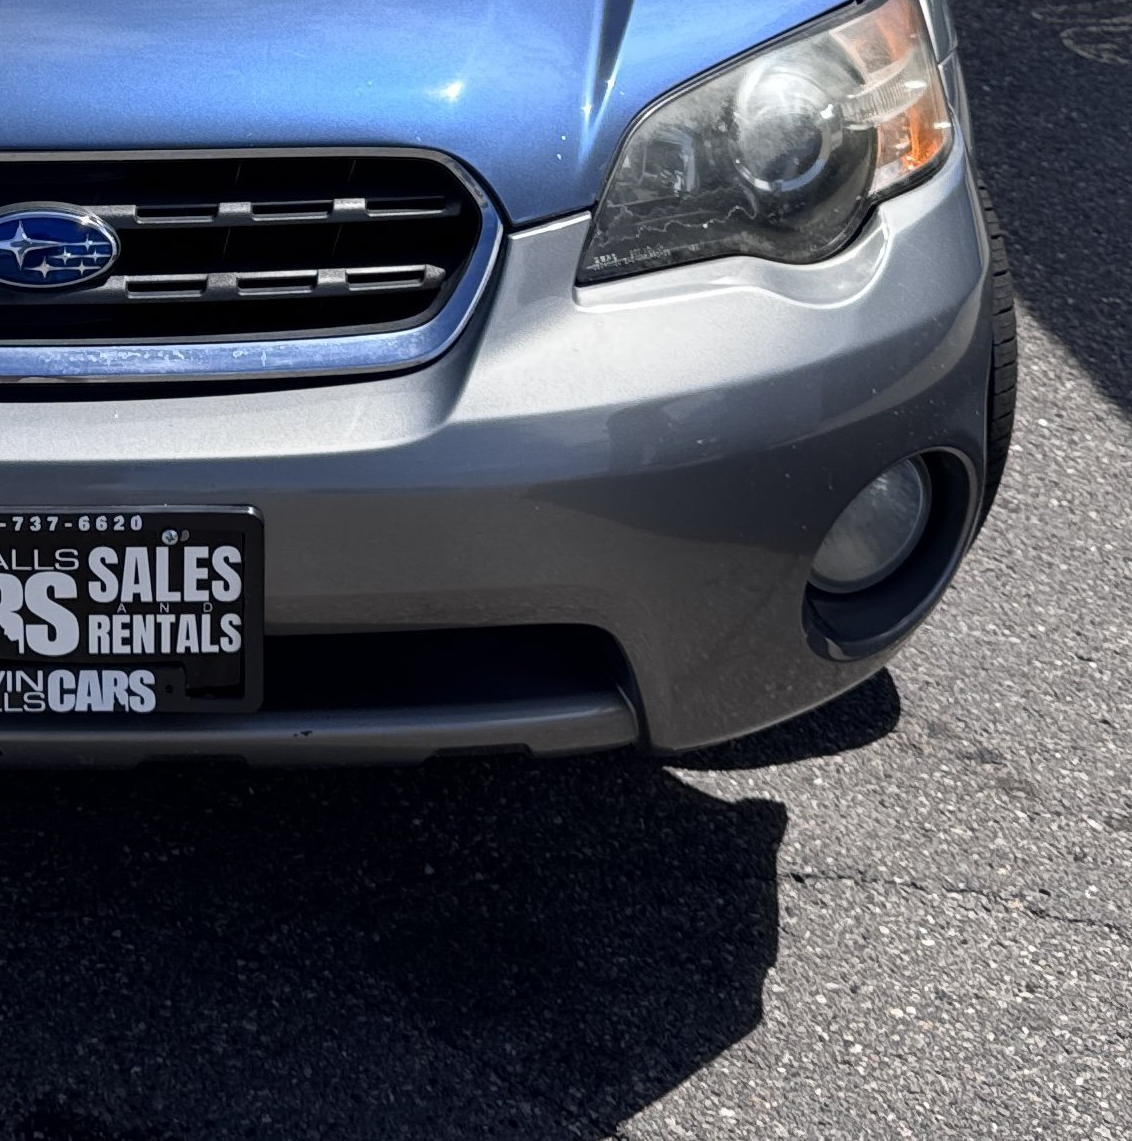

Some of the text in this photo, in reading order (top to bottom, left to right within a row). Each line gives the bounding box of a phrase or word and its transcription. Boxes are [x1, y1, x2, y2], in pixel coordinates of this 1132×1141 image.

[88, 546, 242, 602] SALES
[88, 614, 242, 654] RENTALS
[47, 669, 156, 713] CARS
